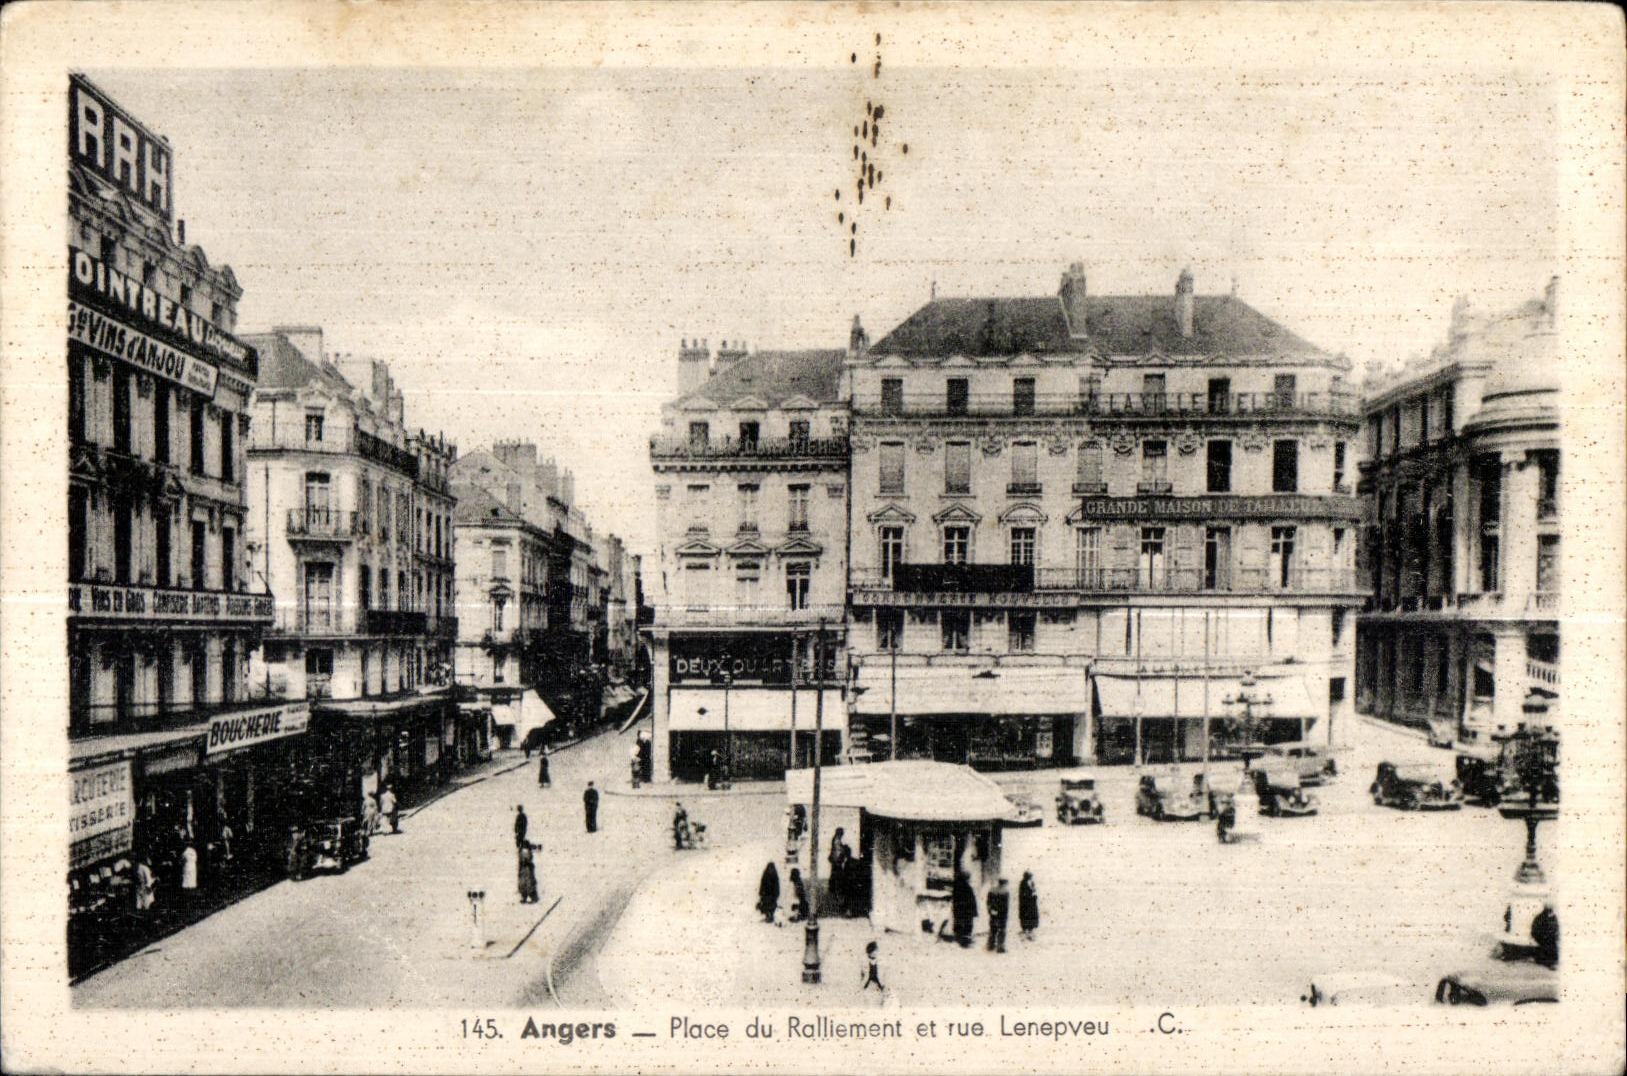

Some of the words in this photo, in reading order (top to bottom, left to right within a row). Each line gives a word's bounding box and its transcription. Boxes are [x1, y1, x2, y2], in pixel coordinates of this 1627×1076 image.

[75, 250, 203, 344] OINTREAU
[88, 310, 127, 355] VINS
[1086, 500, 1148, 514] GRANDE
[1154, 499, 1213, 514] MAISON
[676, 658, 725, 673] DEUX
[209, 710, 283, 748] BOUCHERIE
